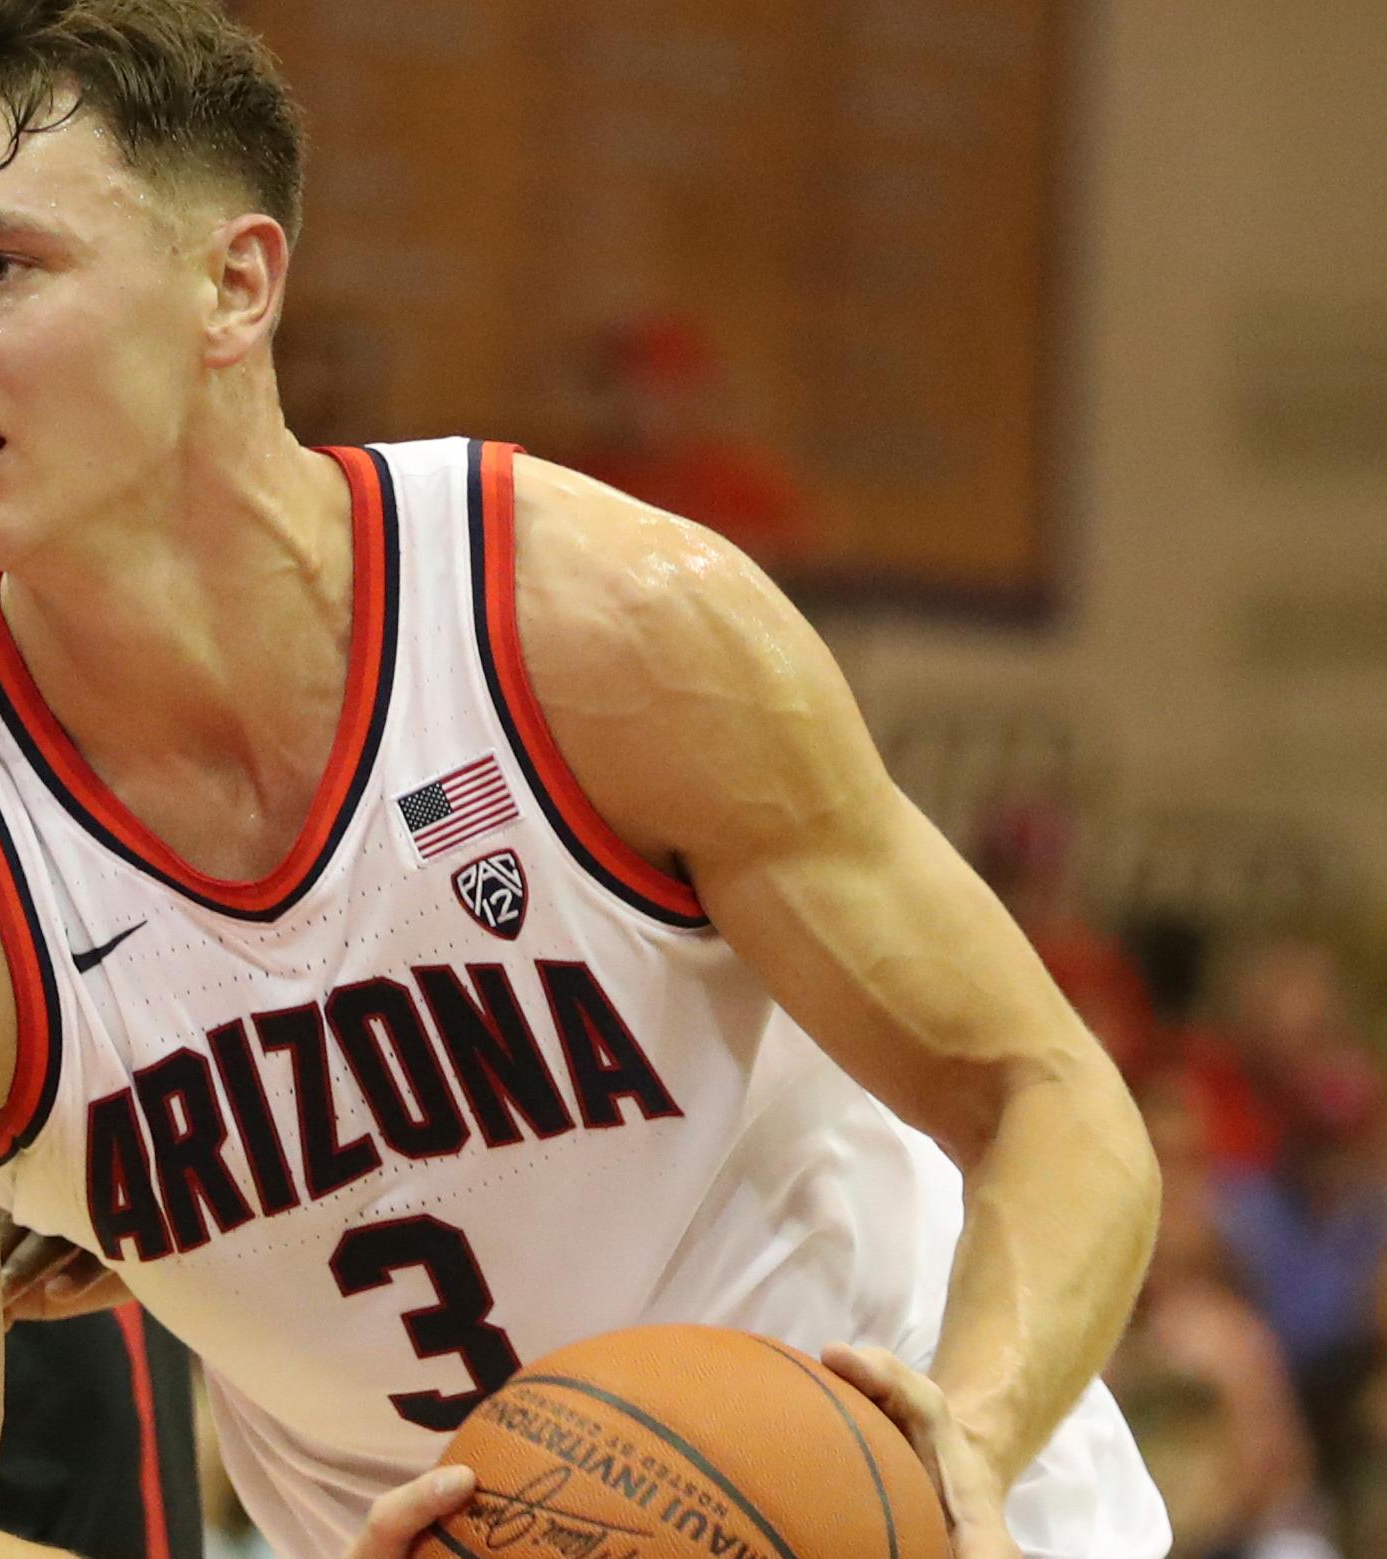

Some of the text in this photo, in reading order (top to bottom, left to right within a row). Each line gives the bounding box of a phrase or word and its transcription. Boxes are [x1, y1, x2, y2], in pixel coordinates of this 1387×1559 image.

[482, 888, 519, 927] 12
[86, 959, 684, 1261] ARIZONA
[328, 1213, 521, 1432] 3
